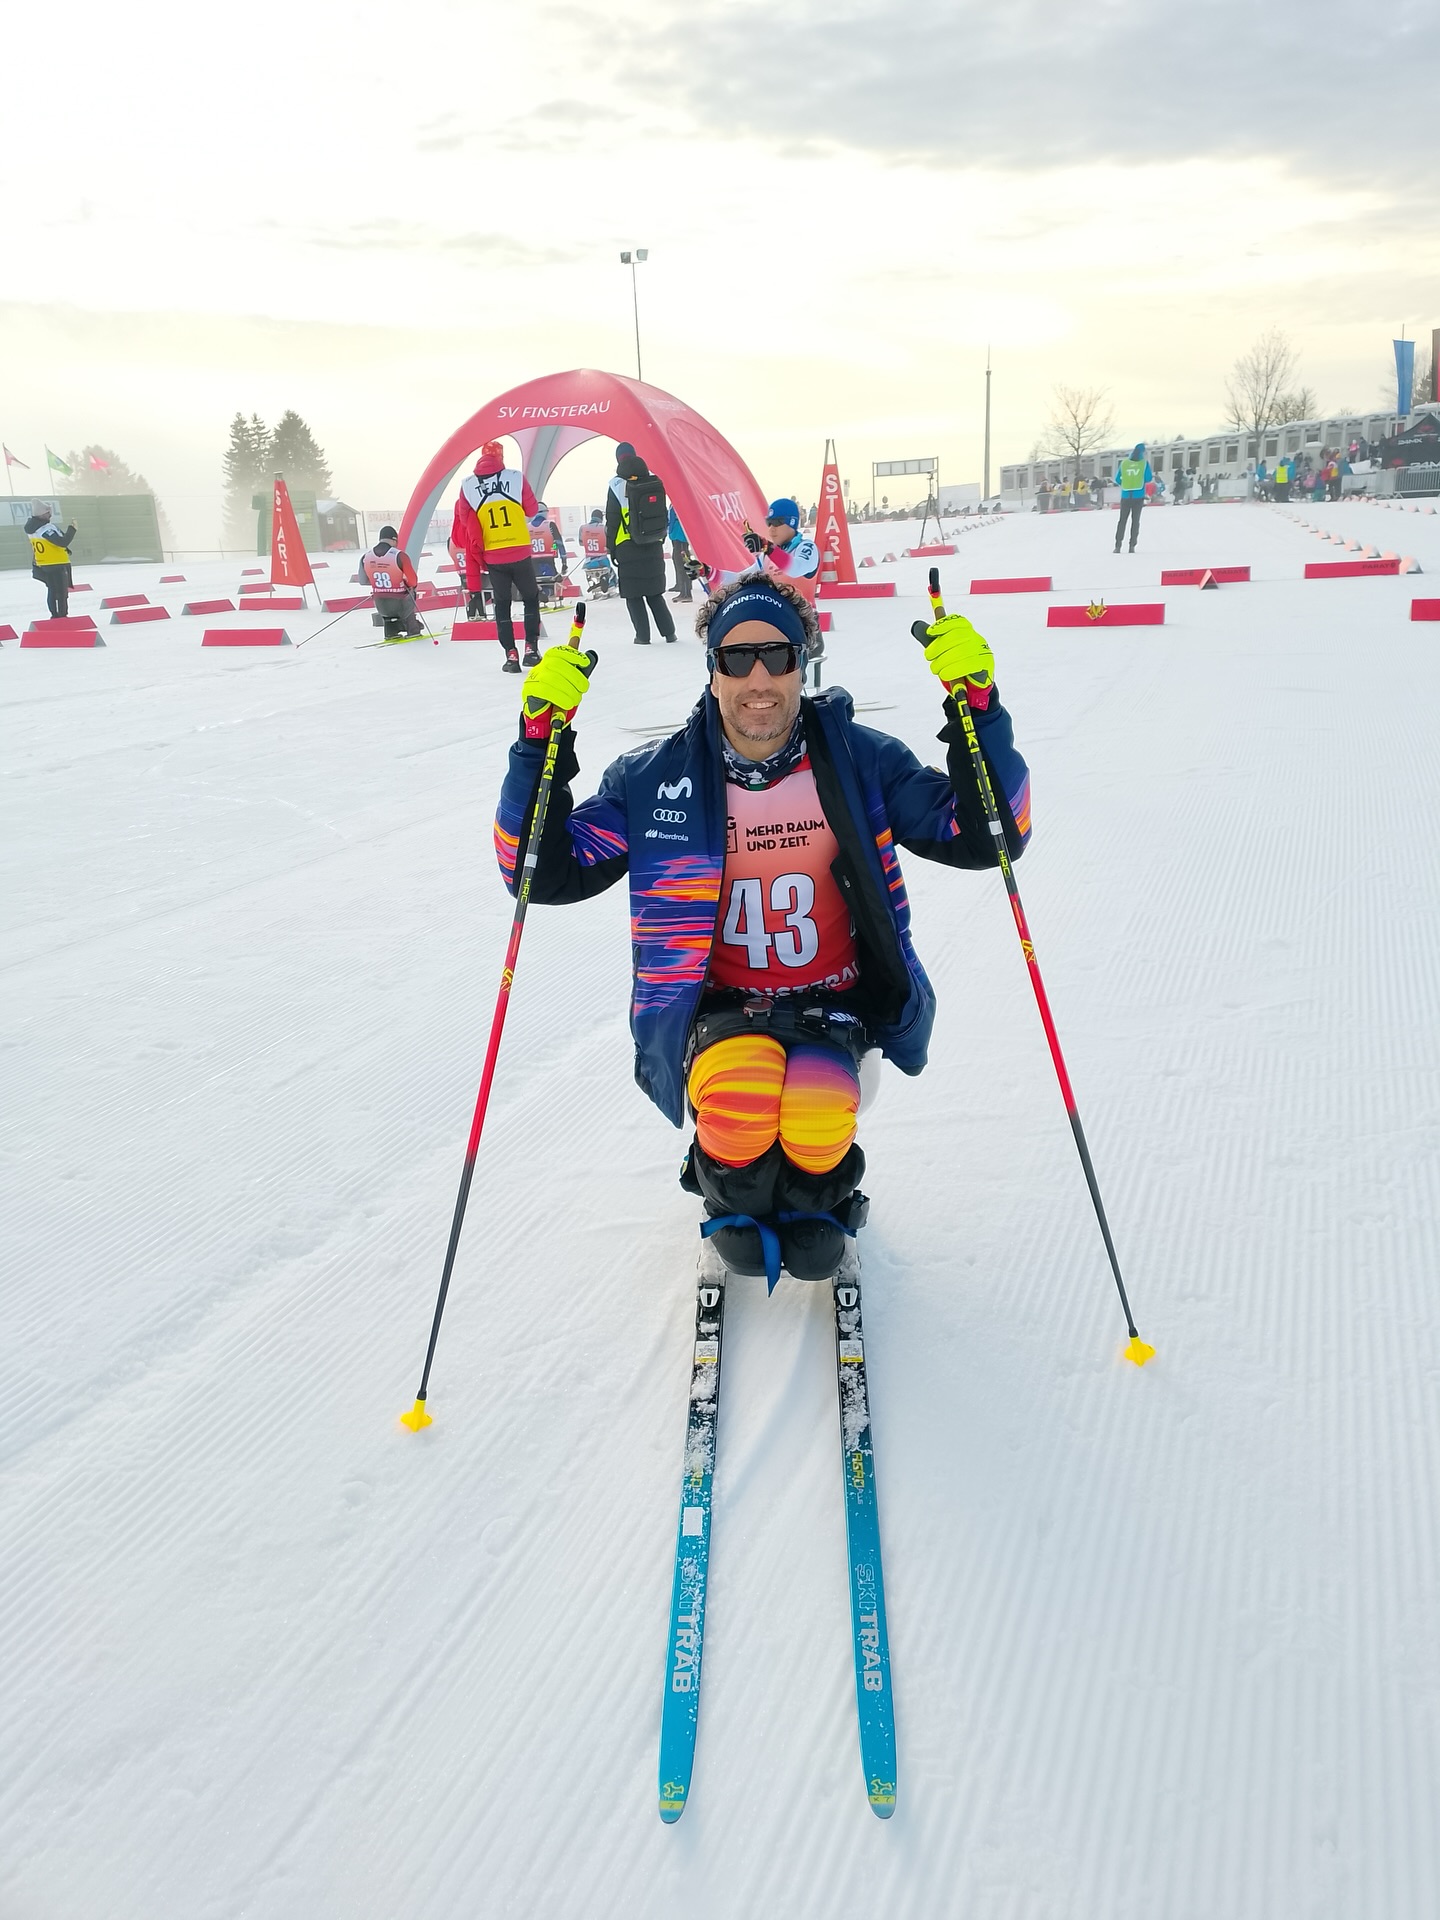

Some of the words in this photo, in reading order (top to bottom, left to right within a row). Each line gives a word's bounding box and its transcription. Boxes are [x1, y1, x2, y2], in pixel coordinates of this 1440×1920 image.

[497, 406, 519, 418] SV
[522, 400, 611, 418] FINSTERAU
[1126, 468, 1141, 476] TV
[488, 505, 512, 529] 11
[824, 473, 842, 562] STAR
[531, 538, 545, 552] 36
[587, 539, 600, 551] 35
[799, 542, 815, 561] USA
[456, 552, 467, 568] 3
[373, 572, 393, 588] 38
[437, 588, 459, 596] START
[722, 593, 783, 616] SPAINSNOW
[957, 699, 981, 754] LEKI
[542, 728, 562, 780] LEKI
[745, 824, 783, 838] MEHR
[786, 819, 825, 833] RAUM
[746, 839, 777, 852] UND
[779, 835, 810, 849] ZEIT.
[722, 872, 819, 969] 43
